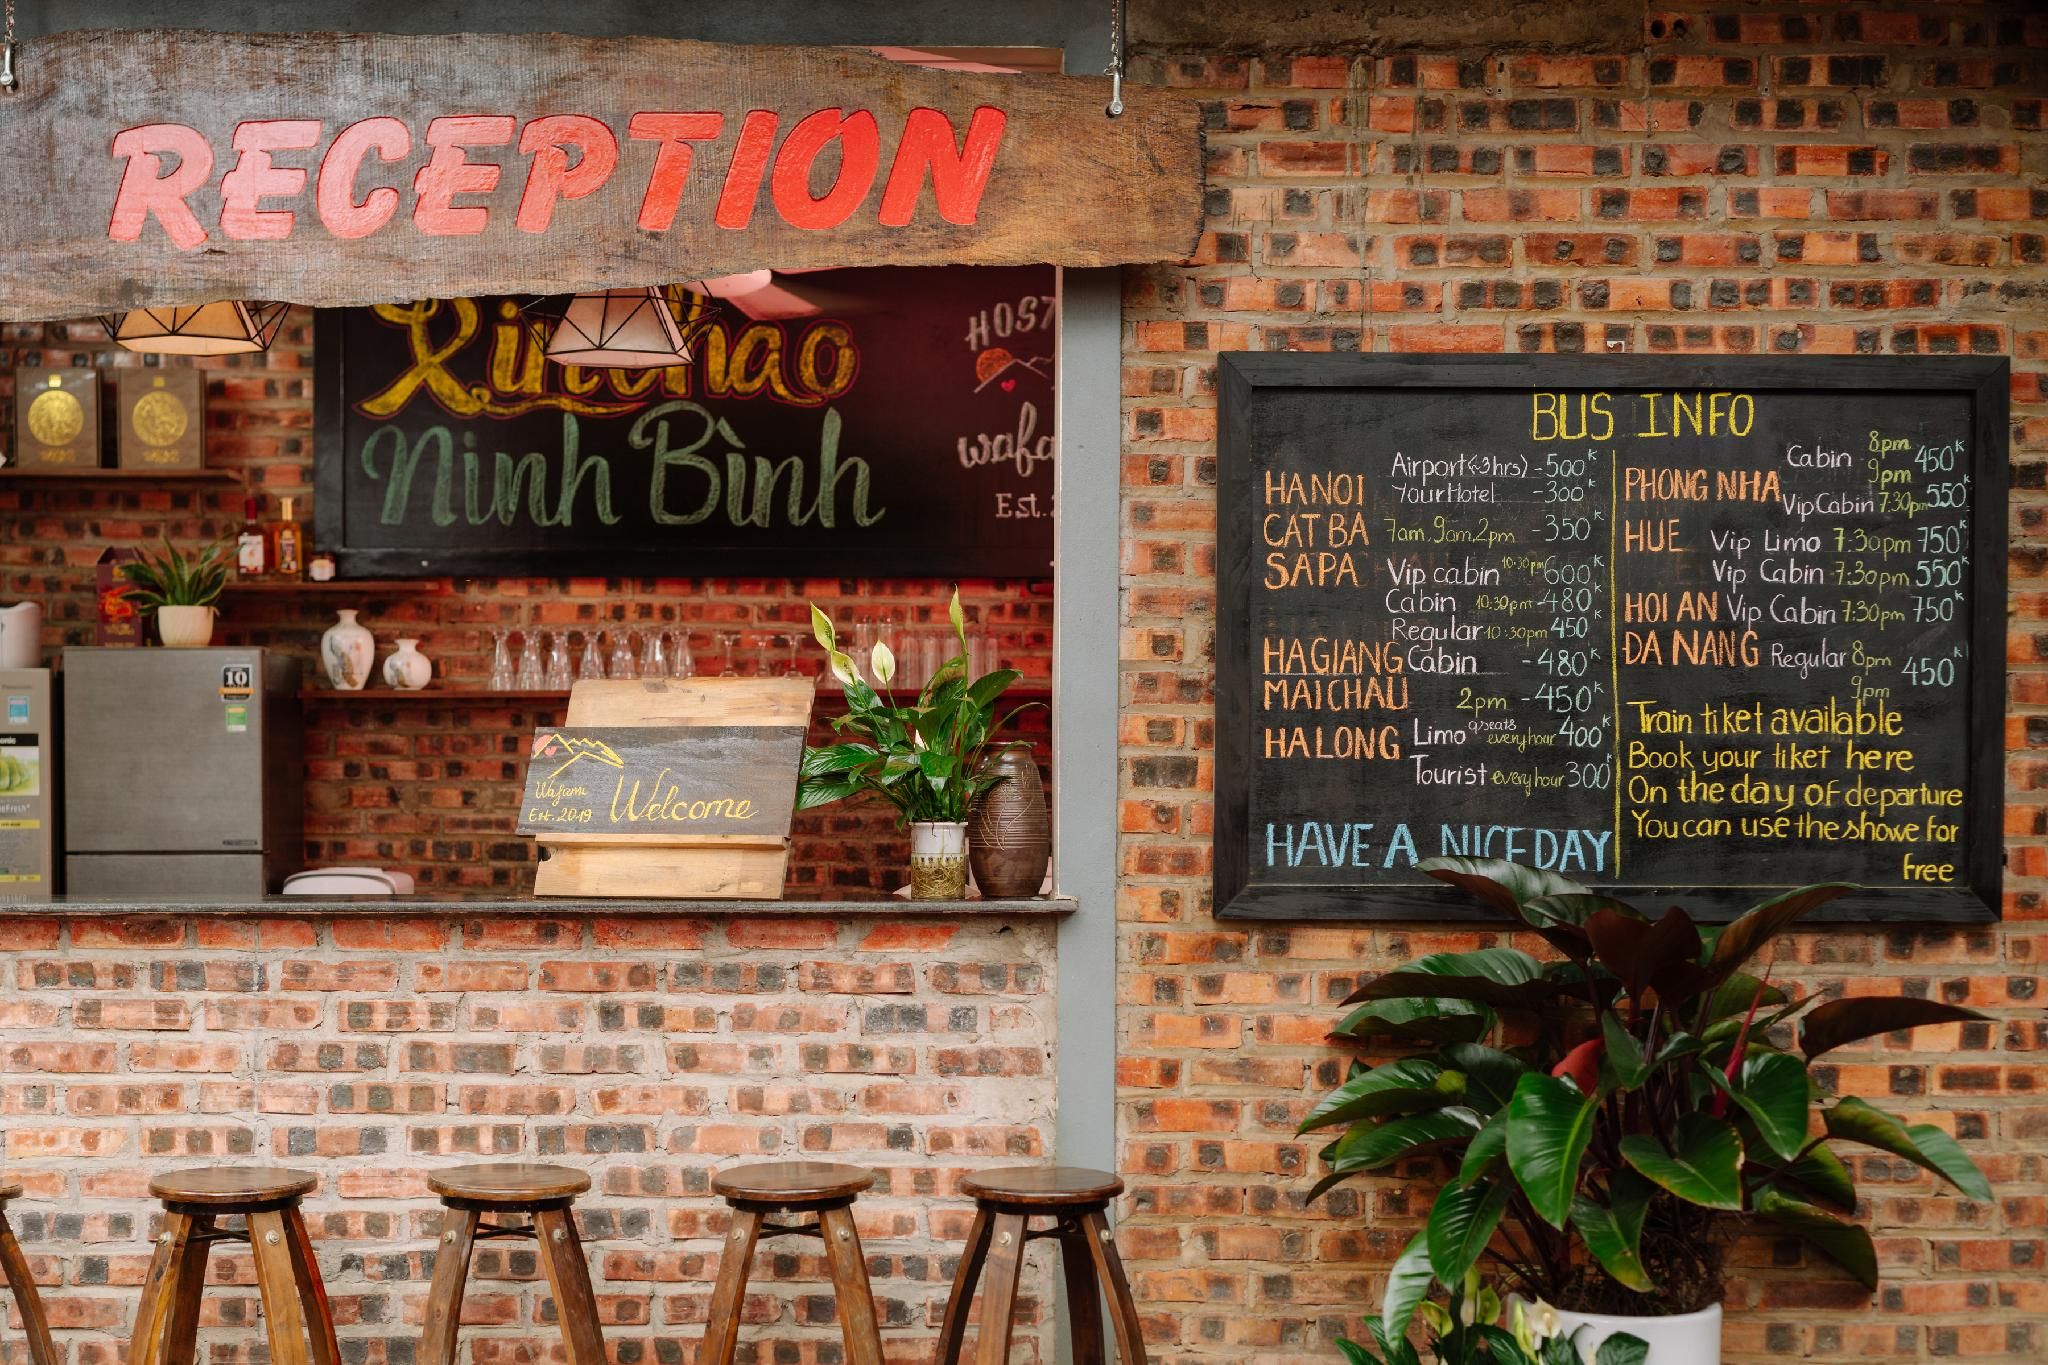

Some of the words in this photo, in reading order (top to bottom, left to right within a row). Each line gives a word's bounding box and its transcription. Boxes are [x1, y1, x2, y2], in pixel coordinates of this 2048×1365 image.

[107, 105, 1006, 250] RECEPTION
[1533, 392, 1614, 441] BUS
[1637, 391, 1755, 438] INFO
[361, 411, 622, 528] Ninh
[628, 401, 887, 529] Bình
[1787, 444, 1852, 468] Cabin
[1868, 431, 1911, 459] 8pm
[1391, 452, 1468, 486] Airport
[1624, 467, 1708, 502] PHONG
[1716, 470, 1782, 503] NHA
[1868, 459, 1912, 491] 9pm
[1264, 470, 1364, 506] HANOI
[1392, 482, 1448, 504] Your
[1445, 482, 1495, 504] Hotel
[1783, 493, 1816, 522] Vip
[1816, 493, 1874, 515] Cabin
[1263, 513, 1321, 548] CAT
[1328, 512, 1370, 548] BA
[1624, 519, 1682, 553] HUE
[1710, 529, 1751, 559] Vip
[1764, 530, 1821, 552] Limo
[1264, 552, 1359, 590] SAPA
[1386, 557, 1426, 594] Vip
[1434, 556, 1499, 586] cabin
[1712, 560, 1746, 594] Vip
[1760, 559, 1824, 585] Cabin
[1385, 588, 1456, 614] Cabin
[1624, 592, 1669, 623] HOI
[1676, 591, 1717, 622] AN
[1726, 593, 1762, 631] Vip
[1770, 593, 1836, 625] Cabin
[1391, 618, 1483, 652] Regular
[1407, 645, 1477, 674] Cabin
[1672, 630, 1759, 667] NANG
[1771, 638, 1847, 680] Regular
[1851, 640, 1892, 678] 8pm
[226, 671, 247, 685] 10
[1850, 676, 1890, 706] 9pm
[1456, 687, 1507, 716] 2pm
[1626, 700, 1693, 735] Train
[1700, 702, 1763, 735] tiket
[1770, 696, 1904, 736] available
[1413, 717, 1466, 747] Limo
[1410, 755, 1488, 786] Tourist
[1629, 741, 1694, 769] Book
[1702, 749, 1762, 776] your
[1774, 742, 1831, 769] tiket
[1846, 740, 1915, 771] here
[609, 768, 759, 823] Welcome
[1628, 775, 1668, 805] On
[1677, 771, 1725, 804] the
[1730, 774, 1795, 814] day
[1805, 779, 1841, 806] of
[1845, 776, 1963, 817] departure
[528, 807, 555, 822] Est.
[556, 806, 592, 823] 2019
[1631, 810, 1679, 839] You
[1681, 818, 1732, 838] can
[1742, 817, 1789, 838] use
[1793, 811, 1840, 840] the
[1927, 817, 1959, 844] for
[1265, 821, 1373, 868] HAVE
[1384, 824, 1419, 869] A
[1534, 829, 1612, 873] DAY
[1902, 852, 1954, 882] free
